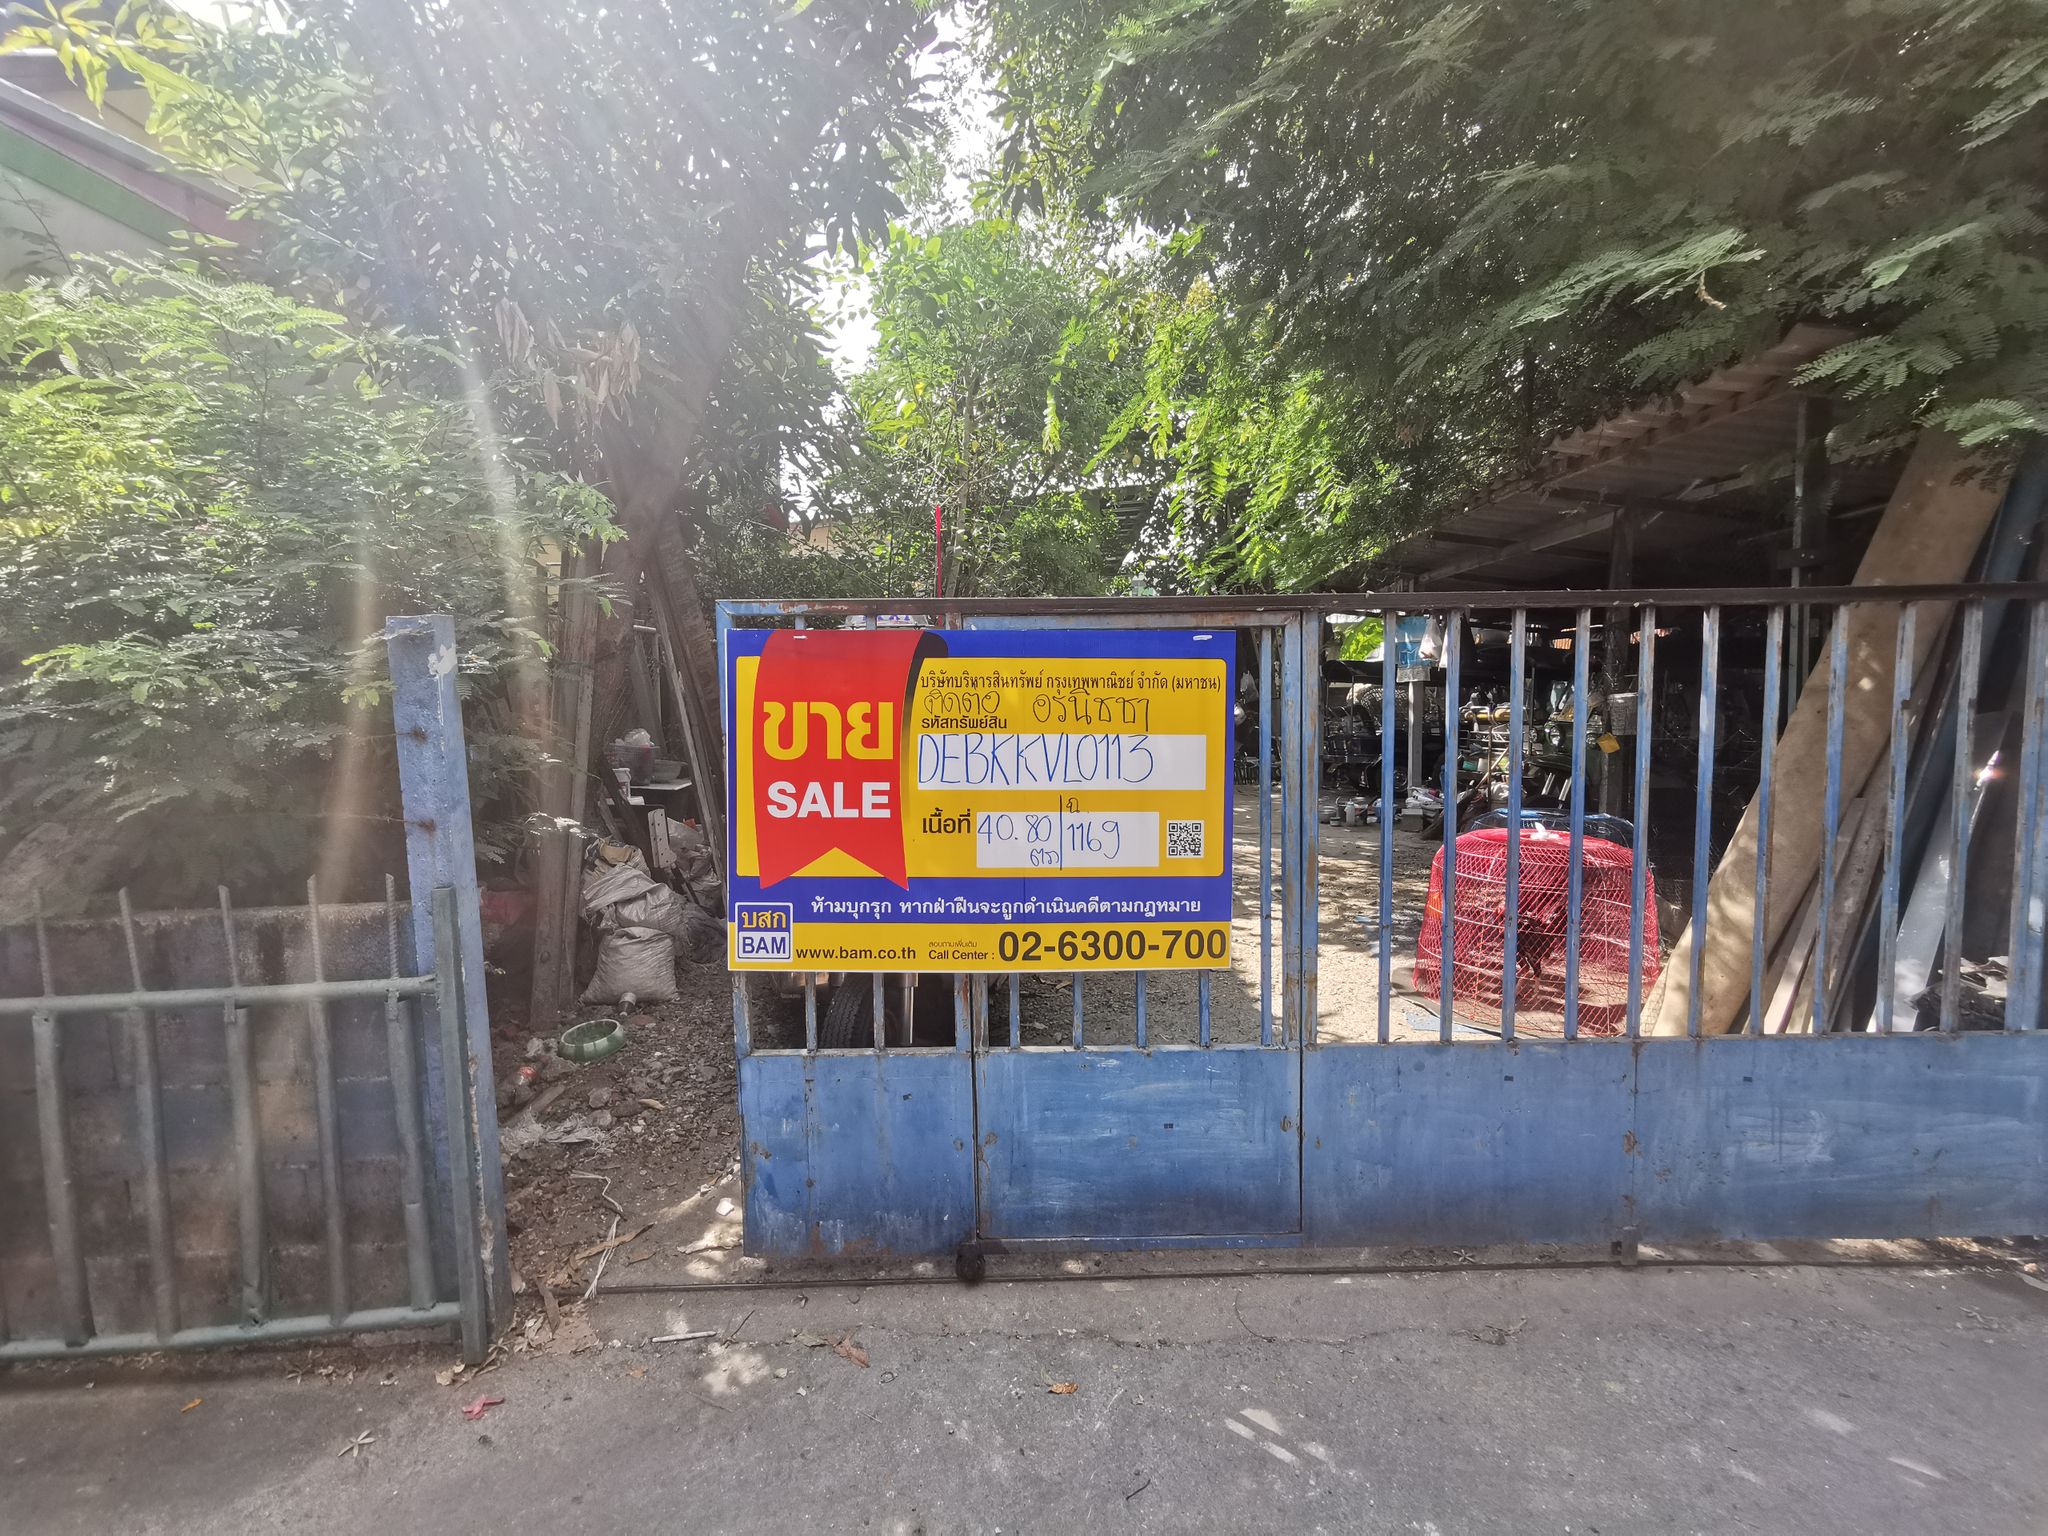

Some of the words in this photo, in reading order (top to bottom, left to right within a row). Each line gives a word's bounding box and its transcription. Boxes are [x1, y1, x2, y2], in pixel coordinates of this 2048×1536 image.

[1046, 669, 1135, 695] กรุงเทพพาณิชย์
[1137, 670, 1168, 690] จำกัด
[1171, 675, 1221, 692] (มหาชน)
[763, 701, 894, 760] ขาย
[921, 714, 1008, 729] รหัสทรัพย์สิน
[767, 781, 891, 818] SALE
[922, 807, 971, 834] เนื้อที่
[741, 910, 787, 928] บสก
[811, 895, 892, 920] ห้ามบุกรุก
[742, 936, 786, 954] BAM
[796, 946, 916, 960] www.bam.co.th
[928, 949, 949, 960] Call
[952, 949, 988, 960] Center
[998, 929, 1227, 962] 02-6300-700
